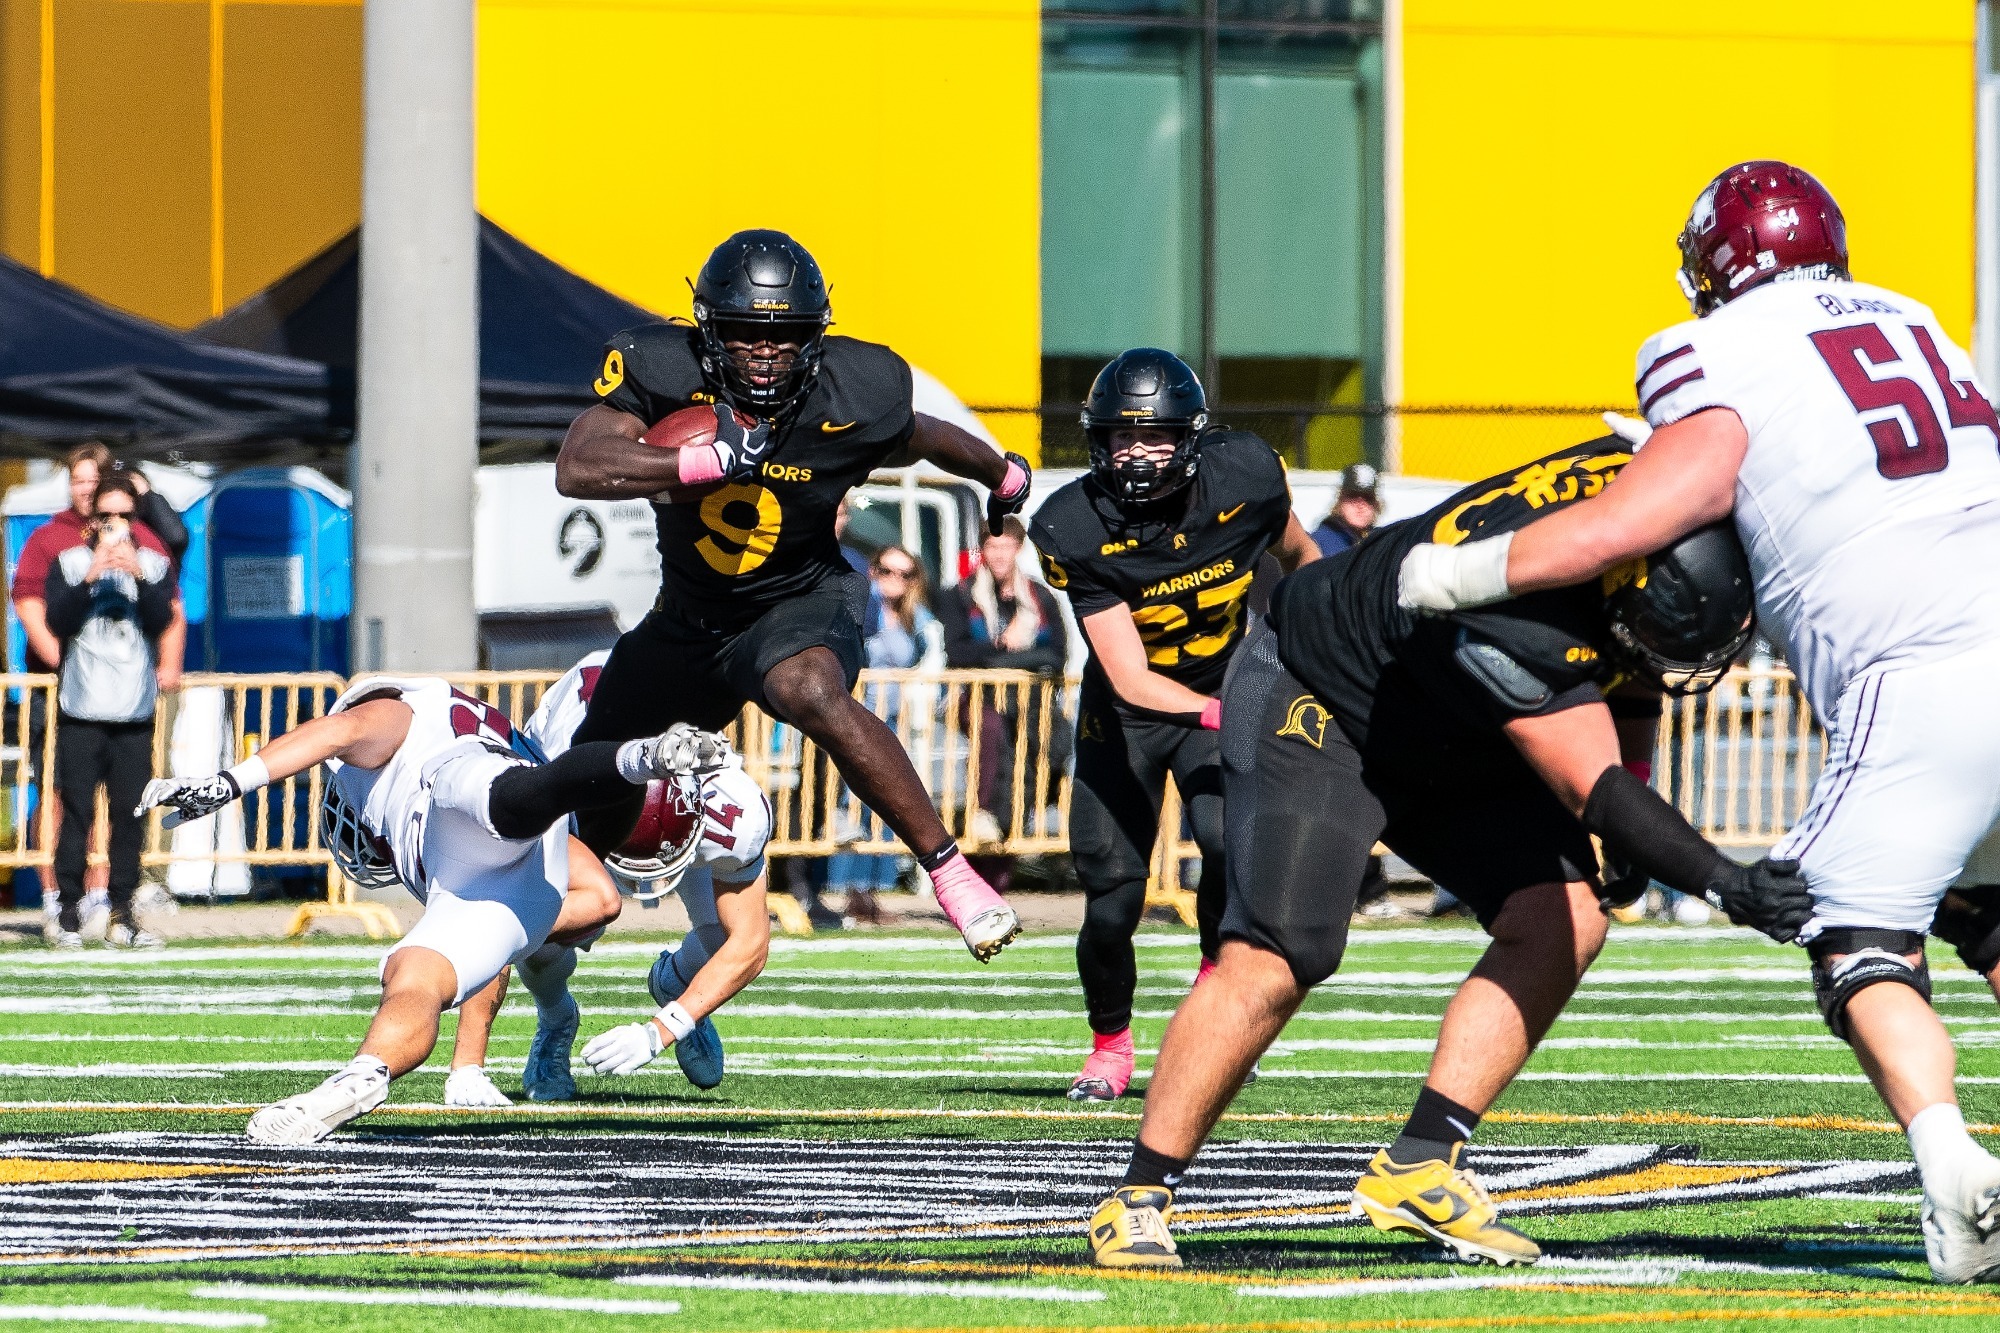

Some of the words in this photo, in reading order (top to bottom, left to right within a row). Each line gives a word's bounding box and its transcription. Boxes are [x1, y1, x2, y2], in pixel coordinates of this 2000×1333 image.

[1777, 207, 1799, 228] 54
[594, 350, 623, 397] 9
[1806, 322, 2000, 479] 54
[762, 461, 812, 481] IORS
[694, 483, 782, 576] 9
[1142, 559, 1235, 599] WARRIORS
